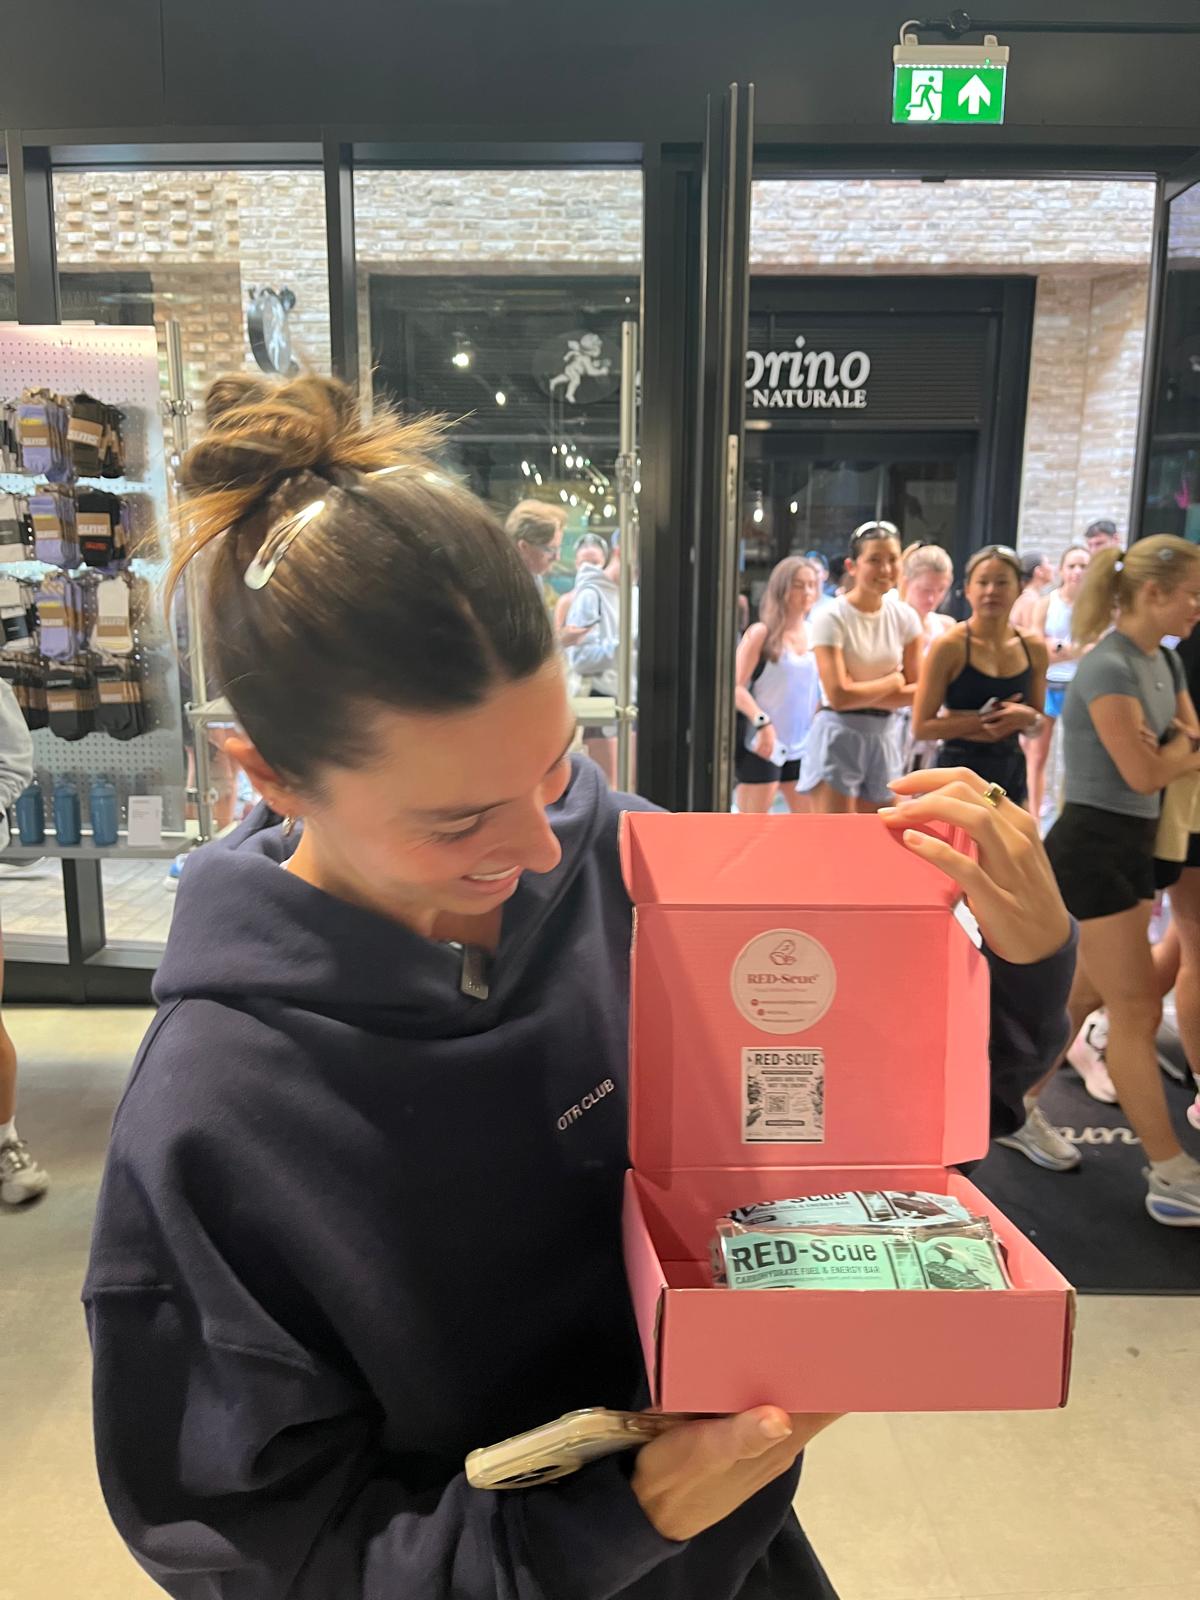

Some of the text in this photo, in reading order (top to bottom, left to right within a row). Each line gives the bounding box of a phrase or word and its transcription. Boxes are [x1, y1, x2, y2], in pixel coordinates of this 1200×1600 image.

[752, 389, 868, 408] NATURALE
[754, 1053, 819, 1066] RED-SCUE
[557, 1078, 615, 1131] OTR CLUB
[731, 1239, 877, 1272] RED-Scue
